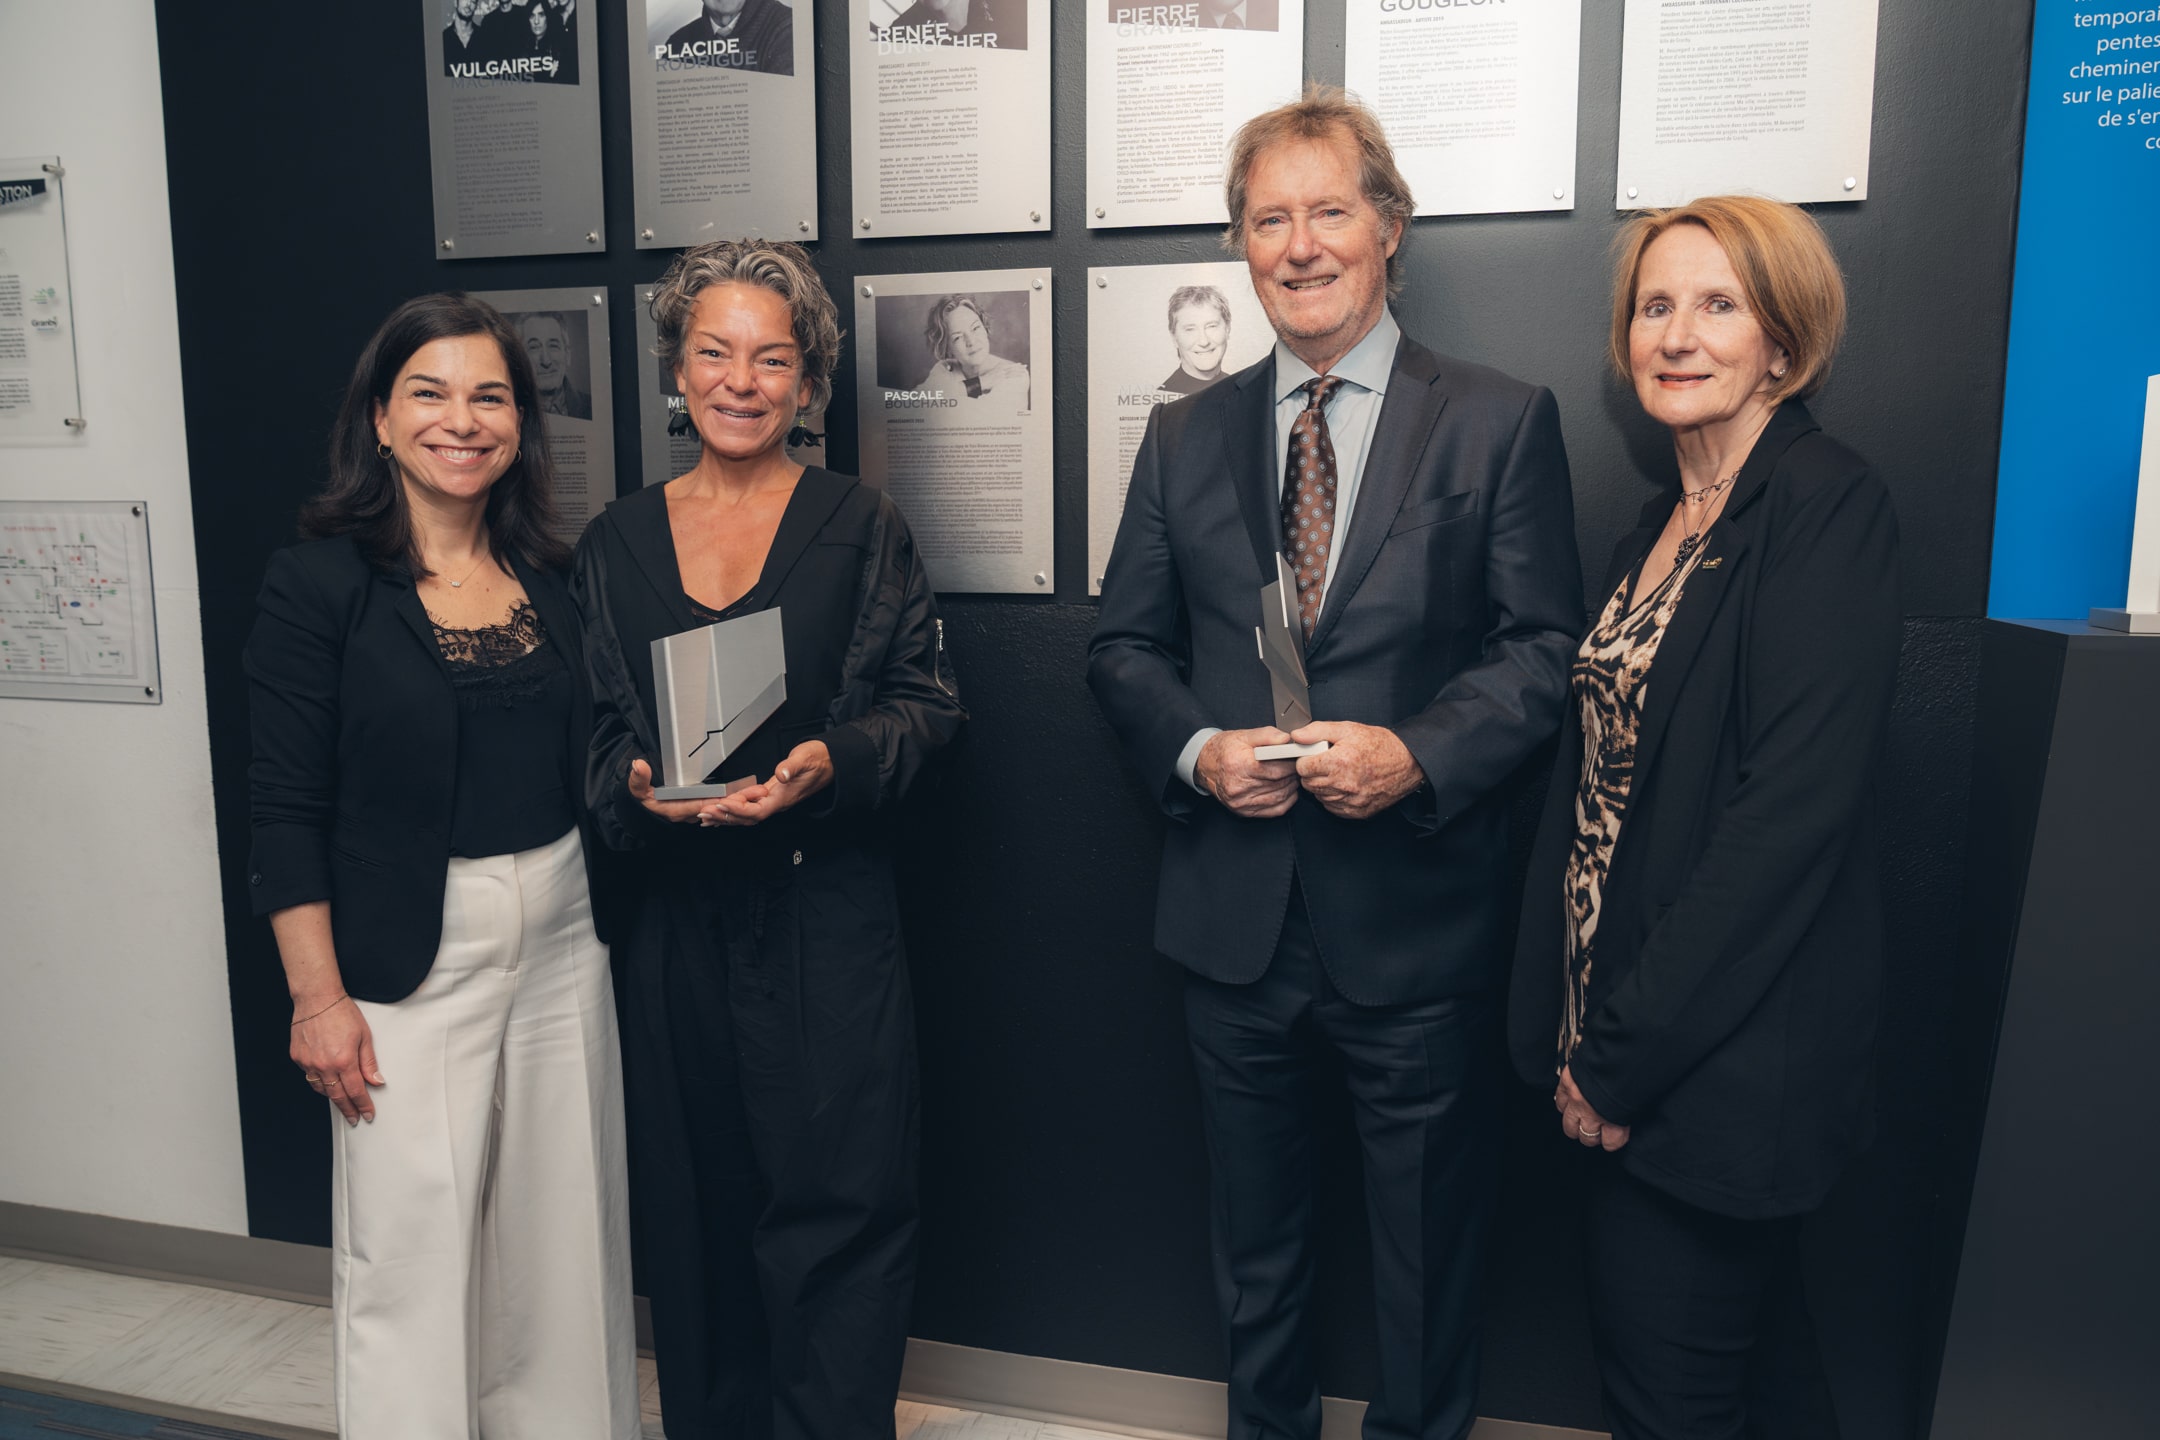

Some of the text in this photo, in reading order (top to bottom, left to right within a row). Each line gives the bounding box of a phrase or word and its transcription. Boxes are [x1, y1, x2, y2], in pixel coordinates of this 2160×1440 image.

[1117, 3, 1199, 24] PIERRE
[1380, 0, 1505, 12] GOUG
[877, 20, 949, 42] RENÉE
[1117, 15, 1208, 38] GRAVEL
[655, 38, 740, 60] PLACIDE
[878, 33, 998, 56] DUROCHER
[2096, 33, 2160, 56] pentes
[449, 56, 554, 79] VULGAIRES
[656, 50, 758, 72] RODRIGUE
[2062, 82, 2160, 105] sur le palie
[2098, 110, 2122, 127] de
[884, 390, 944, 401] PASCALE
[885, 398, 958, 409] BOUCHARD
[1118, 394, 1185, 406] MESSIE
